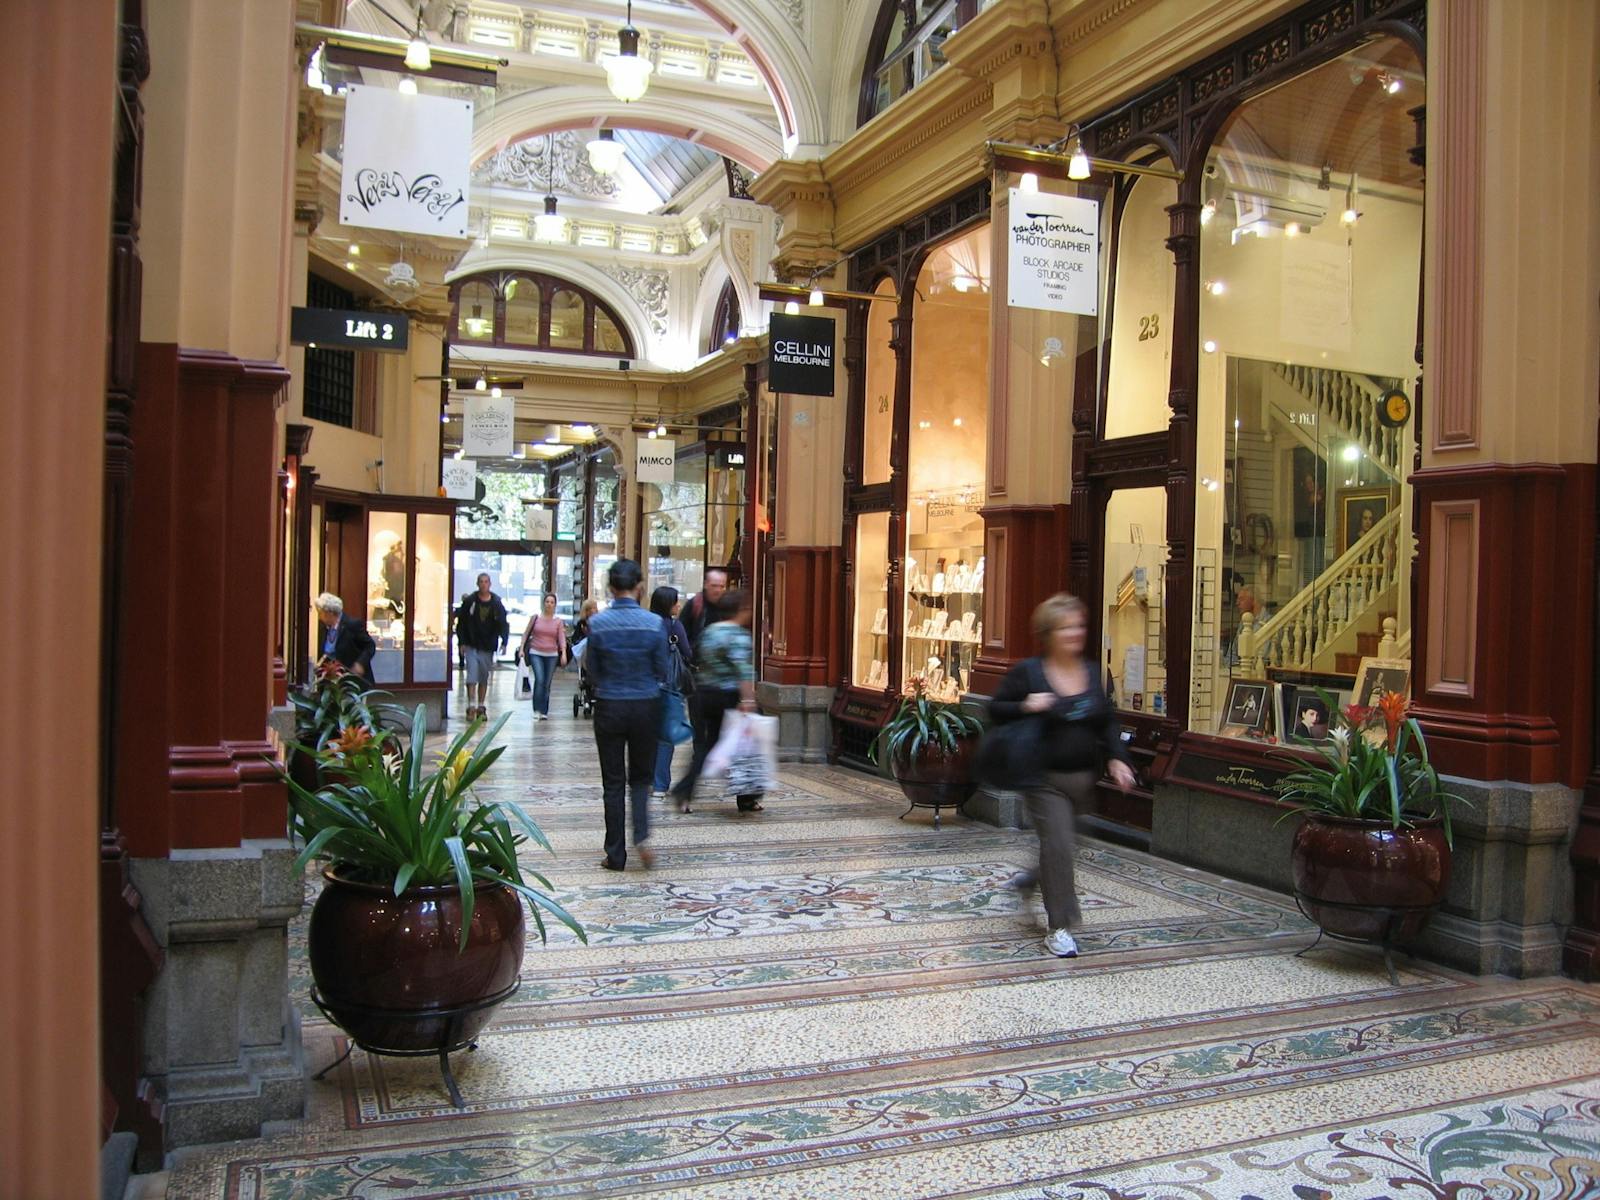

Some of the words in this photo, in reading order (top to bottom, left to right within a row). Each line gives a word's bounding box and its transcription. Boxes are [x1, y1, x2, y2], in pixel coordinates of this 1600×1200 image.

[347, 168, 400, 213] Very
[1015, 233, 1091, 253] PHOTOGRAPHER
[1023, 256, 1050, 268] BLOCK
[1052, 260, 1084, 272] ARCADE
[1036, 269, 1070, 281] STUDIOS
[345, 320, 377, 339] Lift
[382, 324, 393, 340] 2
[1138, 313, 1160, 342] 23
[774, 340, 831, 358] CELLINI
[774, 354, 830, 367] MELBOURNE
[639, 456, 673, 467] MIMCO
[727, 454, 744, 464] Lift
